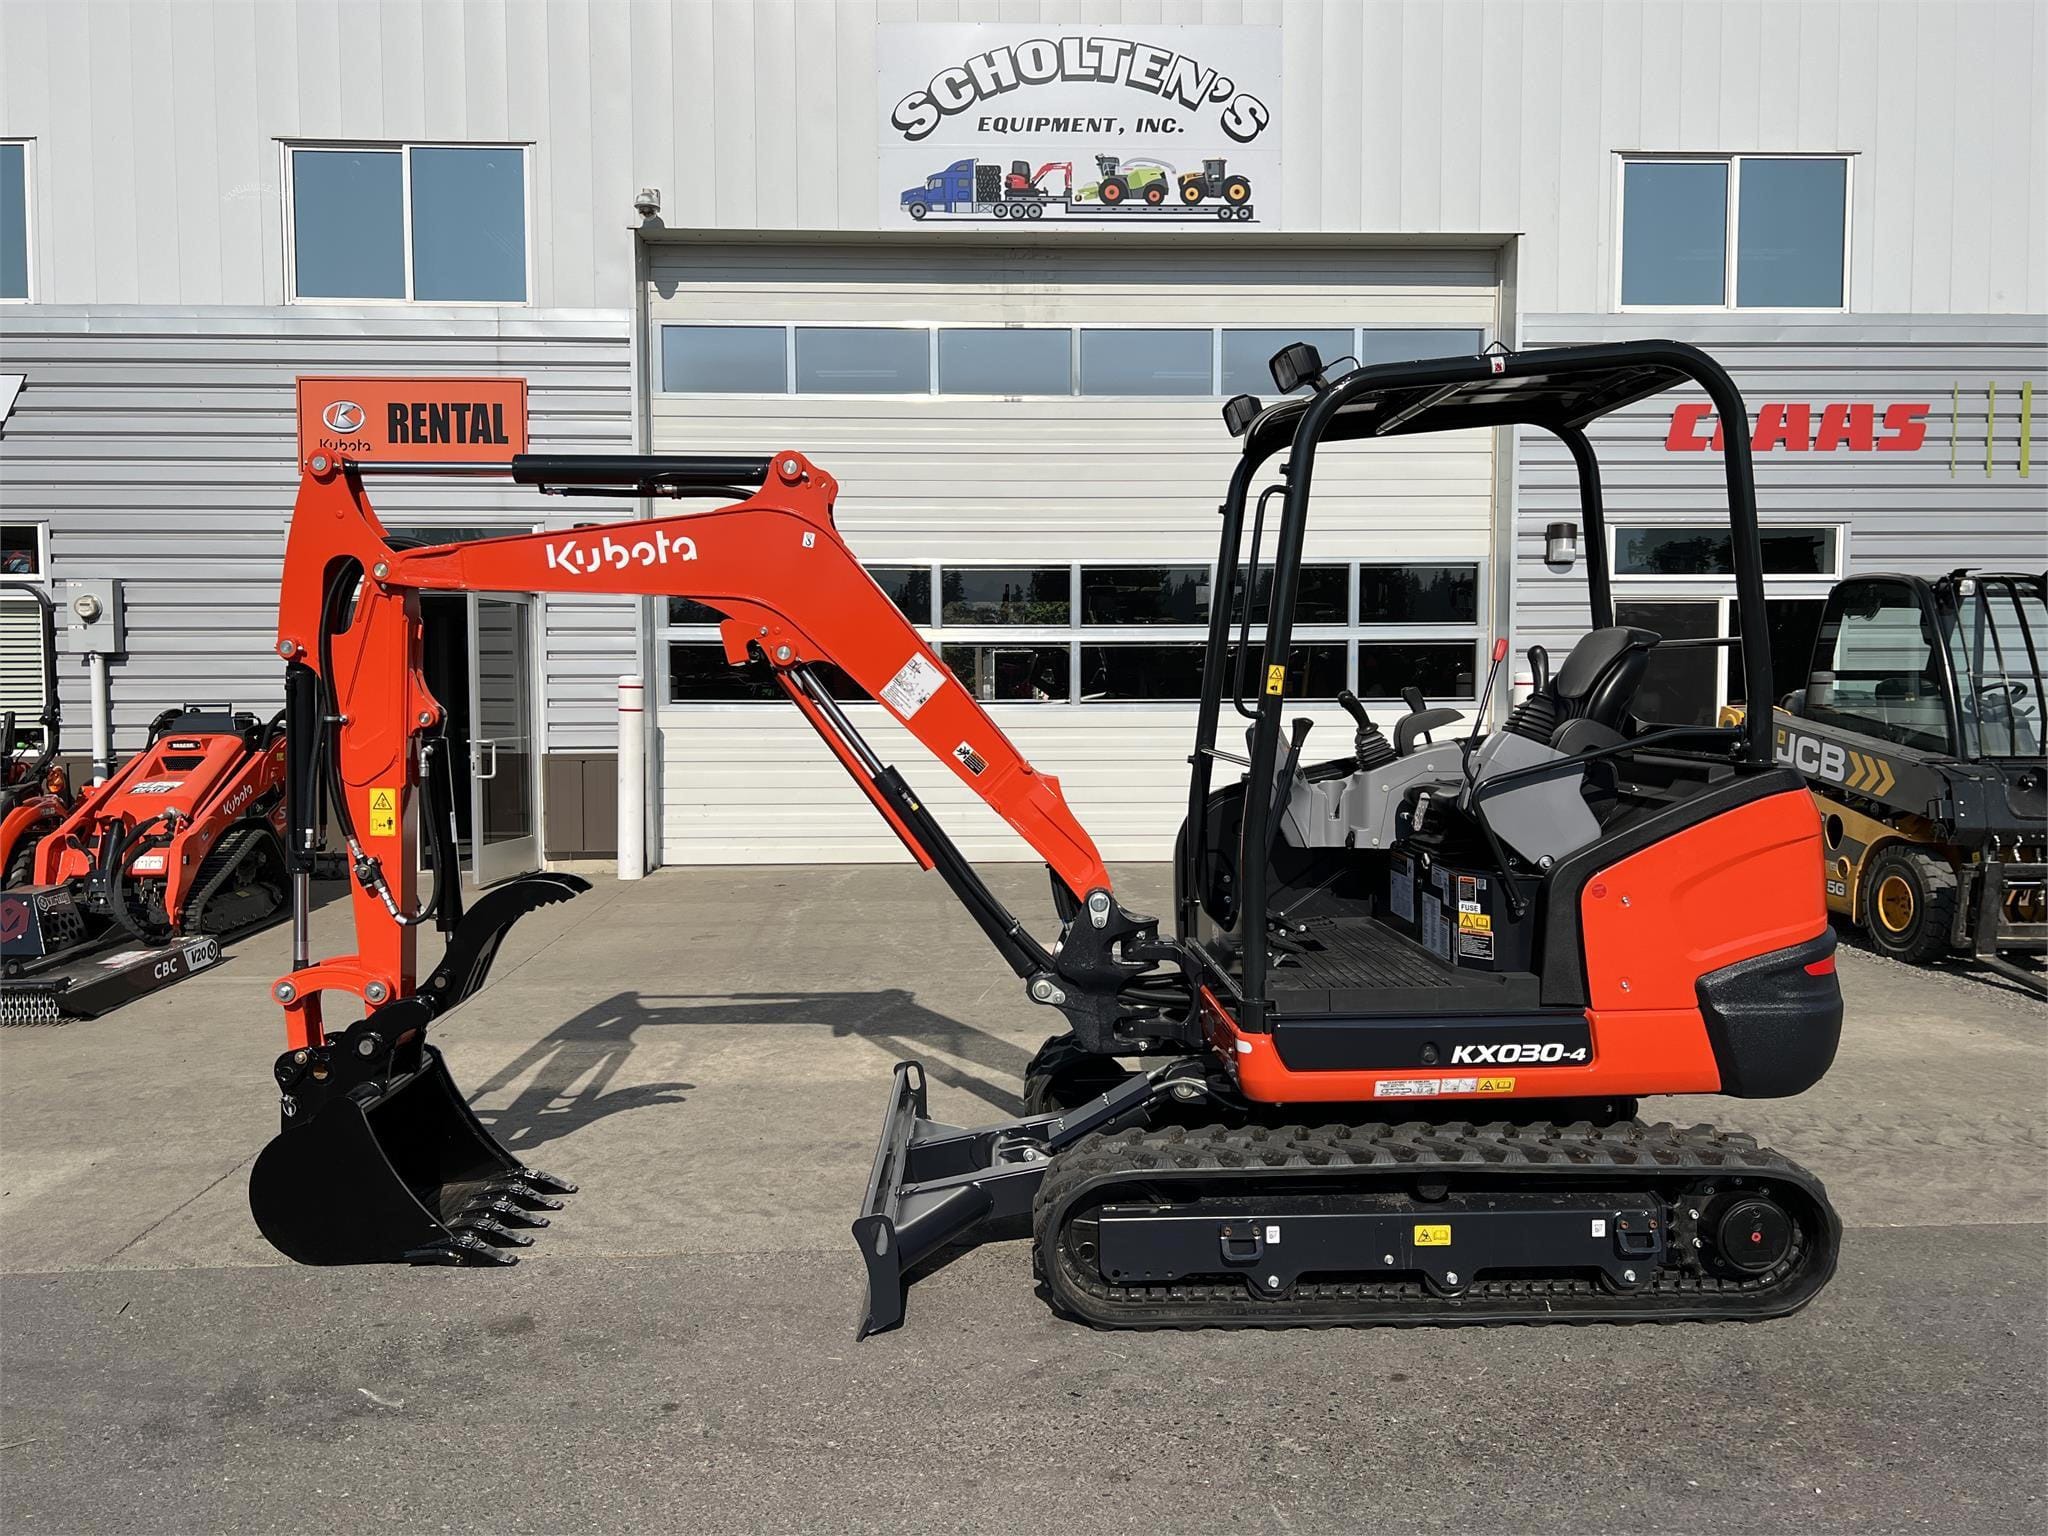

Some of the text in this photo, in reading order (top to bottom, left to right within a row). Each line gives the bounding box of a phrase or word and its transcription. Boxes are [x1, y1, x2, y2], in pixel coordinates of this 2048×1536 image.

[891, 37, 1270, 143] SCHOLTEN'S
[977, 117, 1185, 136] EQUIPMENT, INC.
[387, 403, 509, 444] RENTAL
[1665, 403, 1931, 451] CAAS
[319, 438, 371, 452] Kubota
[545, 530, 698, 575] Kubota
[1776, 733, 1847, 783] JCB
[222, 784, 253, 815] Kubota
[1460, 903, 1480, 913] FUSE
[154, 946, 207, 980] CBC V20
[1450, 1043, 1587, 1065] KX030-4
